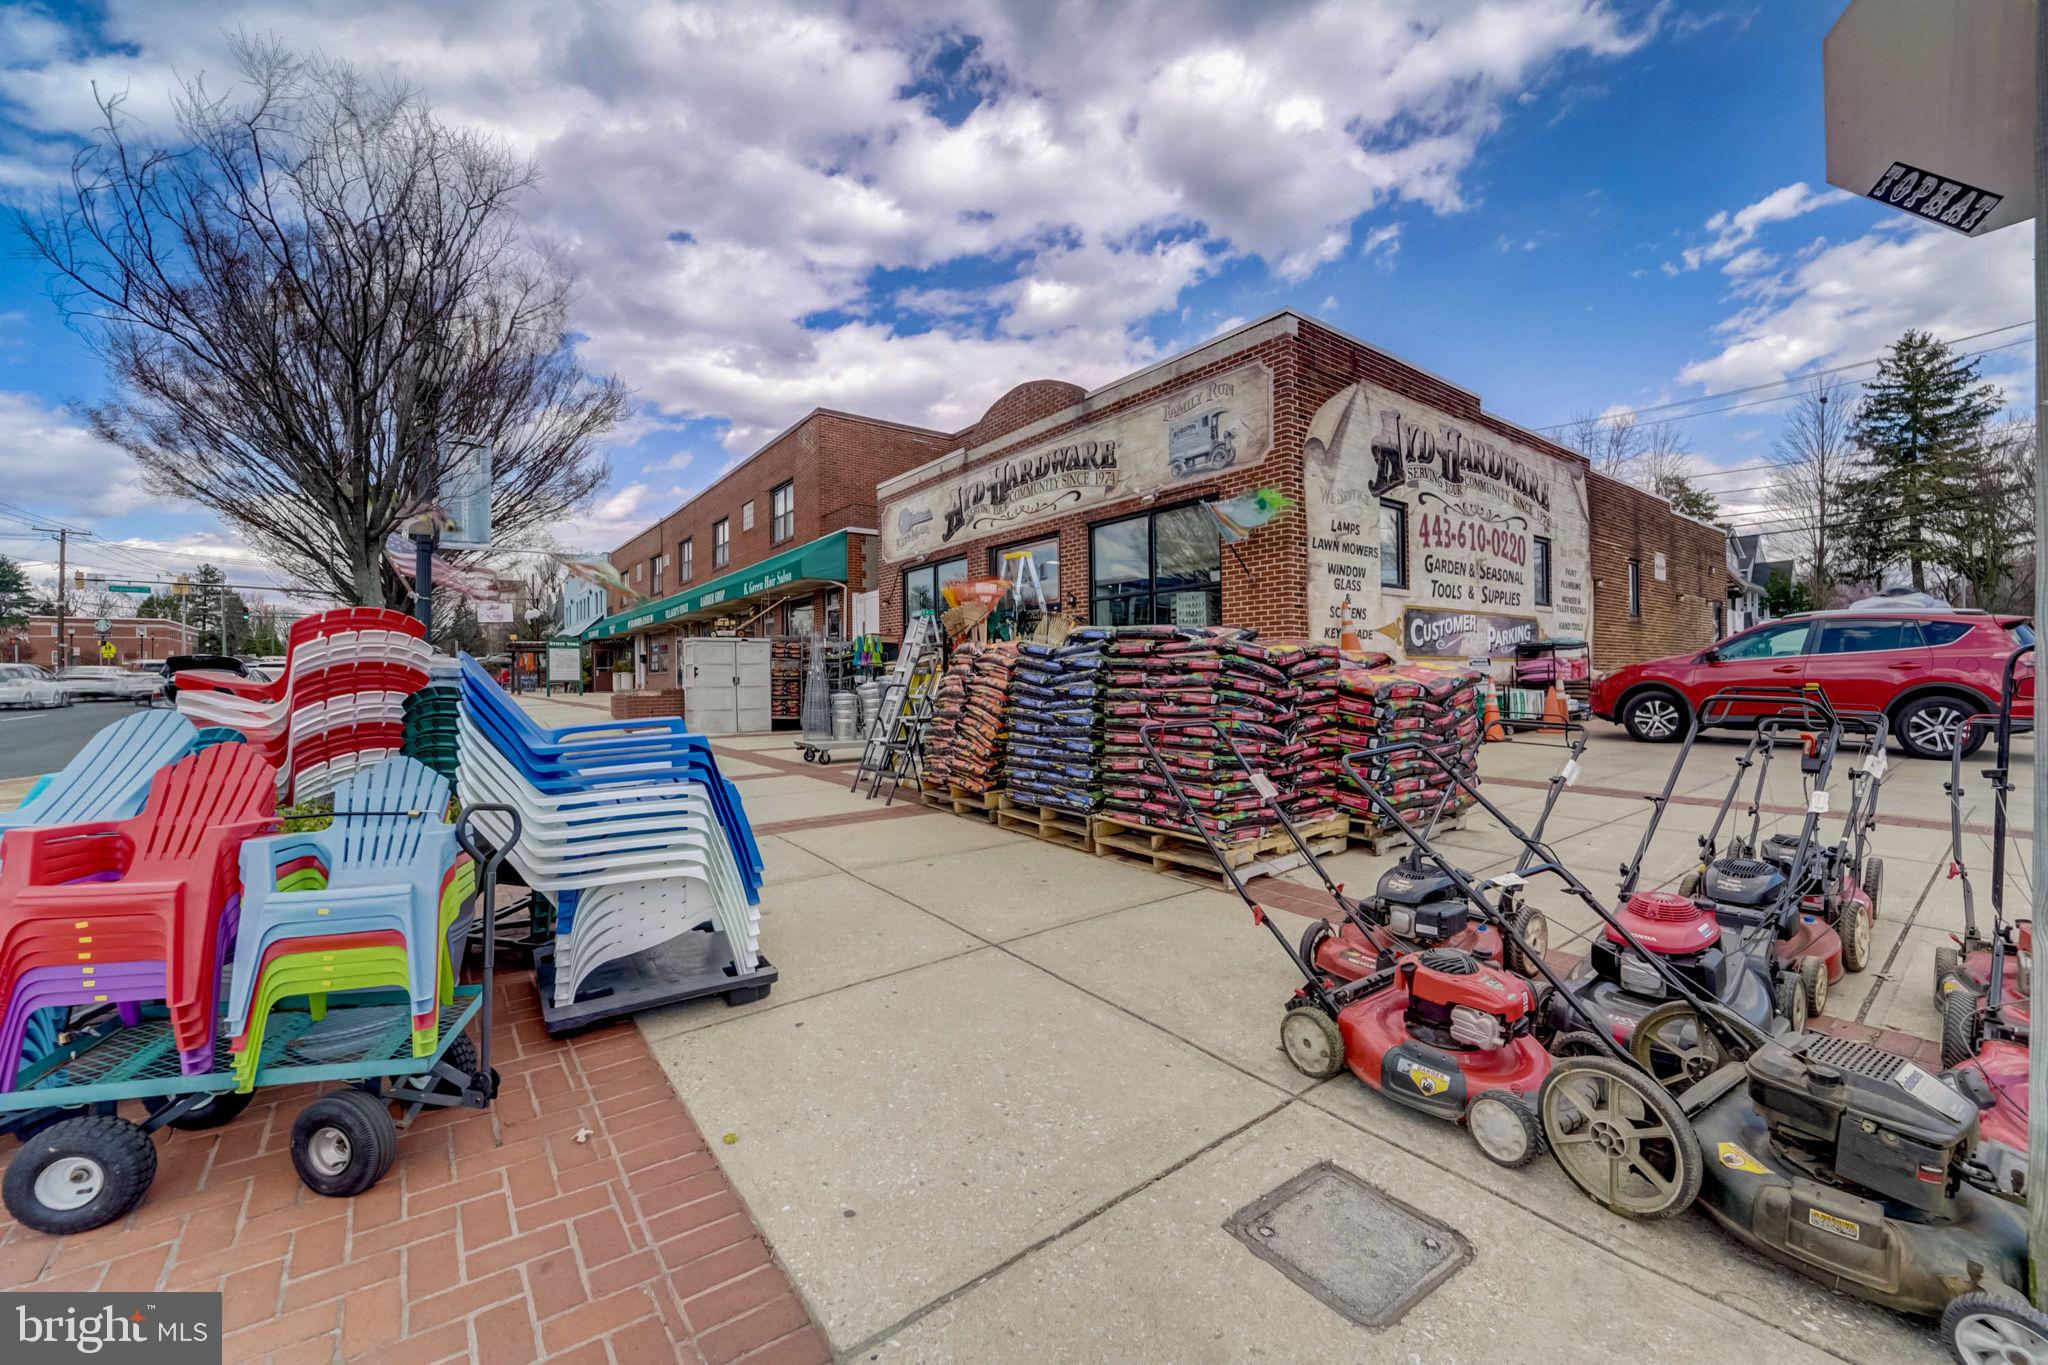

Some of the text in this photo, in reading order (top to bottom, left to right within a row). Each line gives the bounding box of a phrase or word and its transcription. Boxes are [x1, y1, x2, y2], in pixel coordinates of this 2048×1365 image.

[1874, 165, 2000, 230] TOPHAT
[1162, 383, 1234, 421] FAMILY RUN
[1368, 410, 1550, 512] AYD HARDWARE
[942, 440, 1117, 542] AYD HARDWARE
[1009, 477, 1060, 501] COMMUNITY
[1062, 472, 1089, 486] SINCE
[1095, 471, 1116, 484] 1974
[1407, 465, 1442, 488] SERVING
[1464, 476, 1509, 502] COMMUNITY
[1513, 495, 1533, 515] SINCE
[1331, 519, 1361, 536] LAMPS
[1419, 513, 1526, 567] 443-610-0220
[1312, 537, 1378, 559] LAWN MOWERS
[1327, 562, 1366, 578] WINDOW
[1424, 554, 1524, 585] GARDEN & SEASONAL
[1334, 579, 1361, 592] GLASS
[1431, 580, 1521, 607] TOOLS & SUPPLIES
[1330, 606, 1367, 620] SCENS
[1324, 627, 1373, 640] KEY ADE
[1410, 614, 1477, 647] CUSTOMER
[1488, 624, 1531, 651] PARKING
[1820, 1213, 1856, 1230] WARNING
